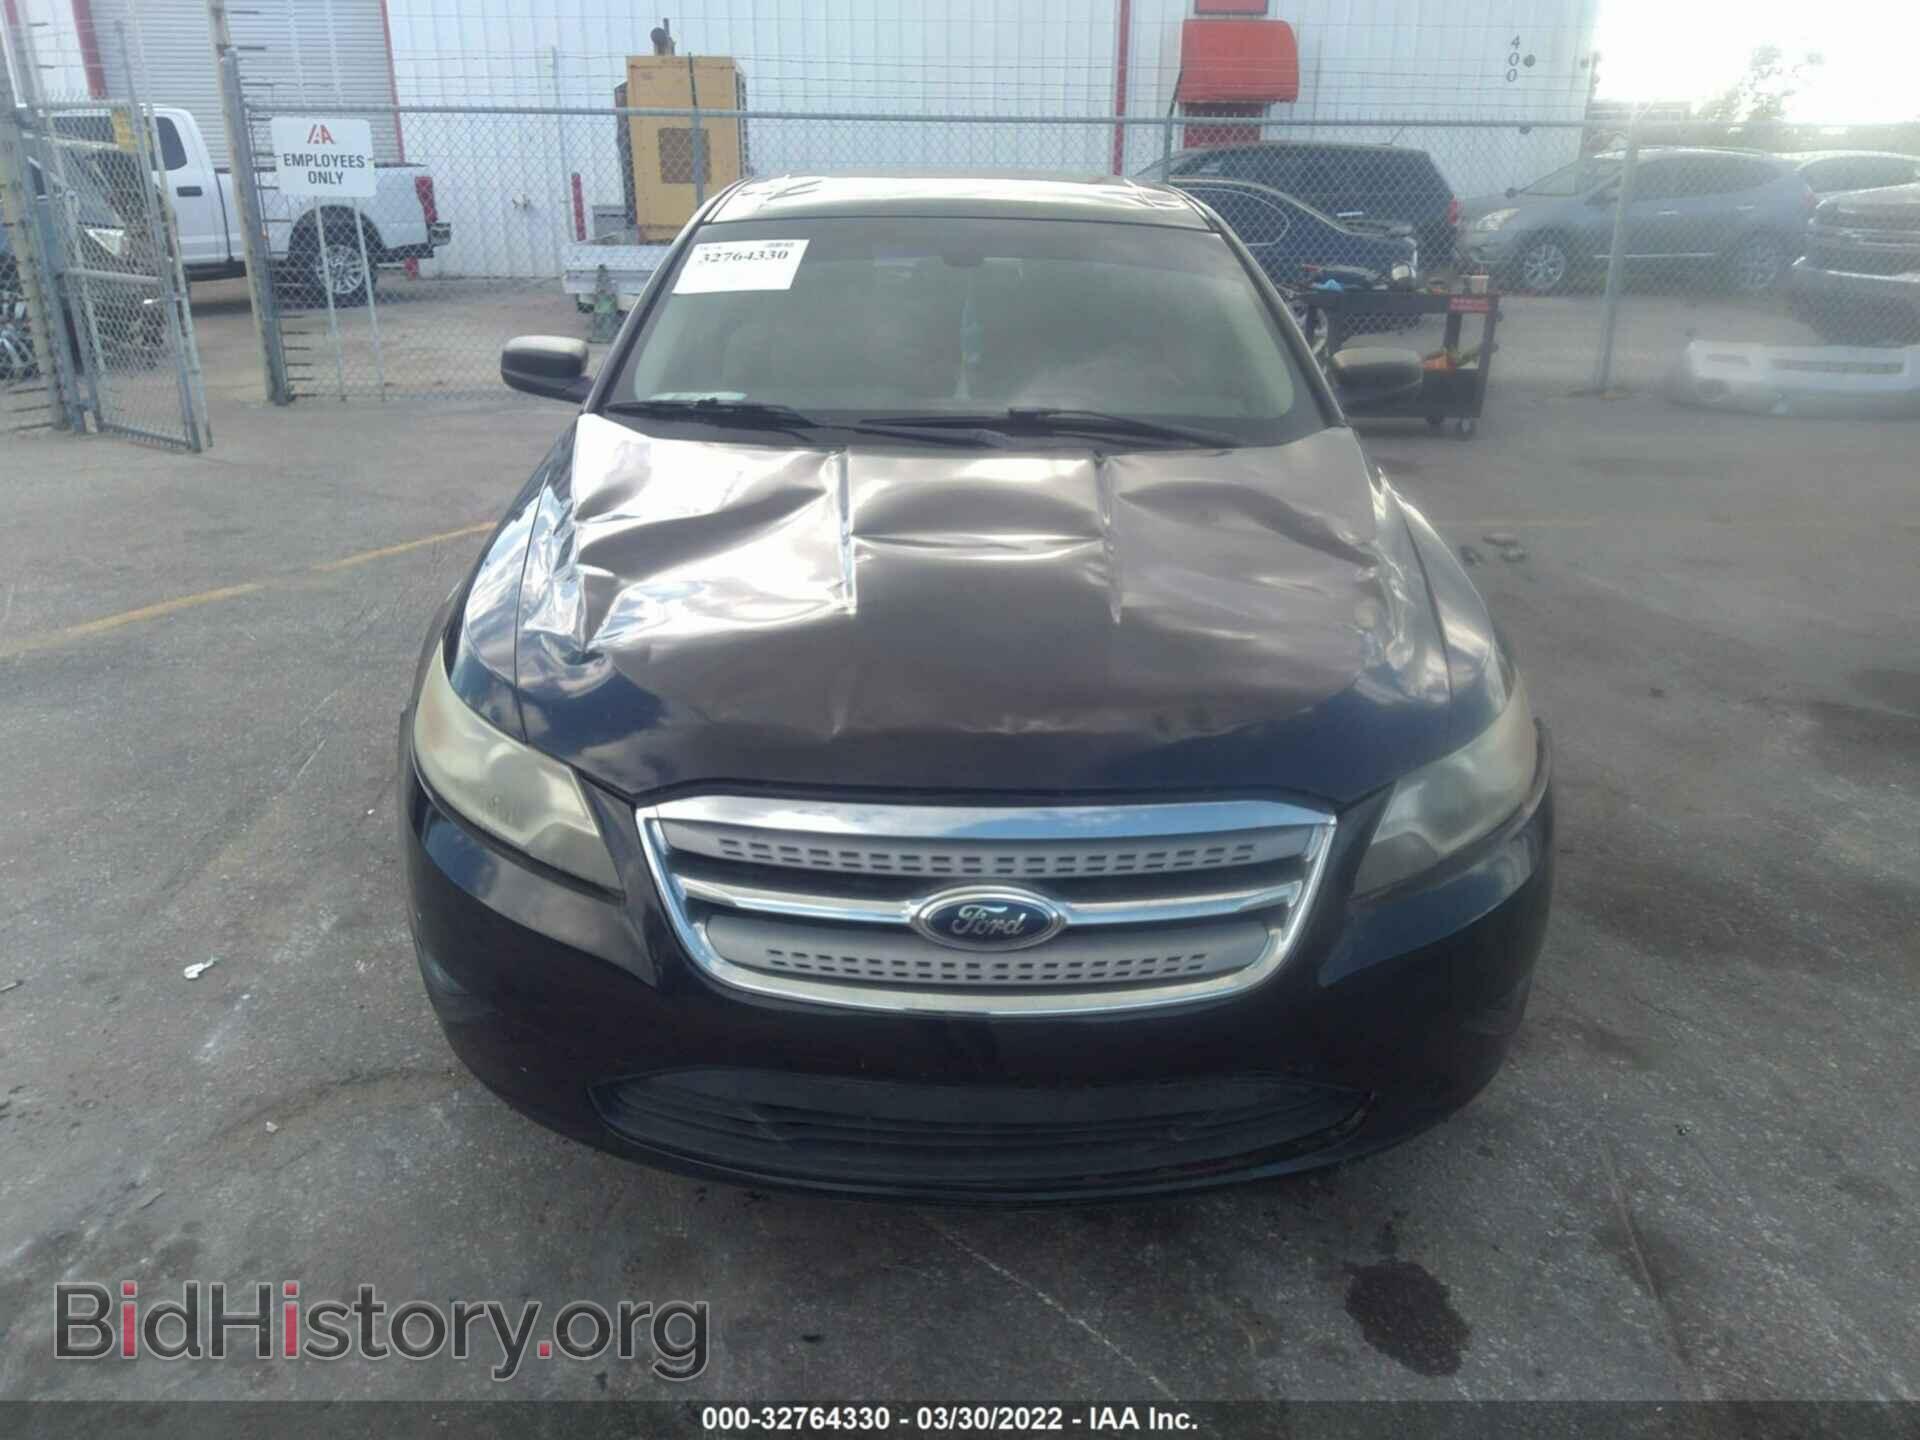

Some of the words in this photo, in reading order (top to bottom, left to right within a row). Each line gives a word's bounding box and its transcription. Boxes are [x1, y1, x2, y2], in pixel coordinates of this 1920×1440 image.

[283, 153, 365, 168] EMPLOYEES
[307, 171, 344, 184] ONLY
[697, 250, 789, 264] 32764330
[951, 904, 1027, 935] Ford
